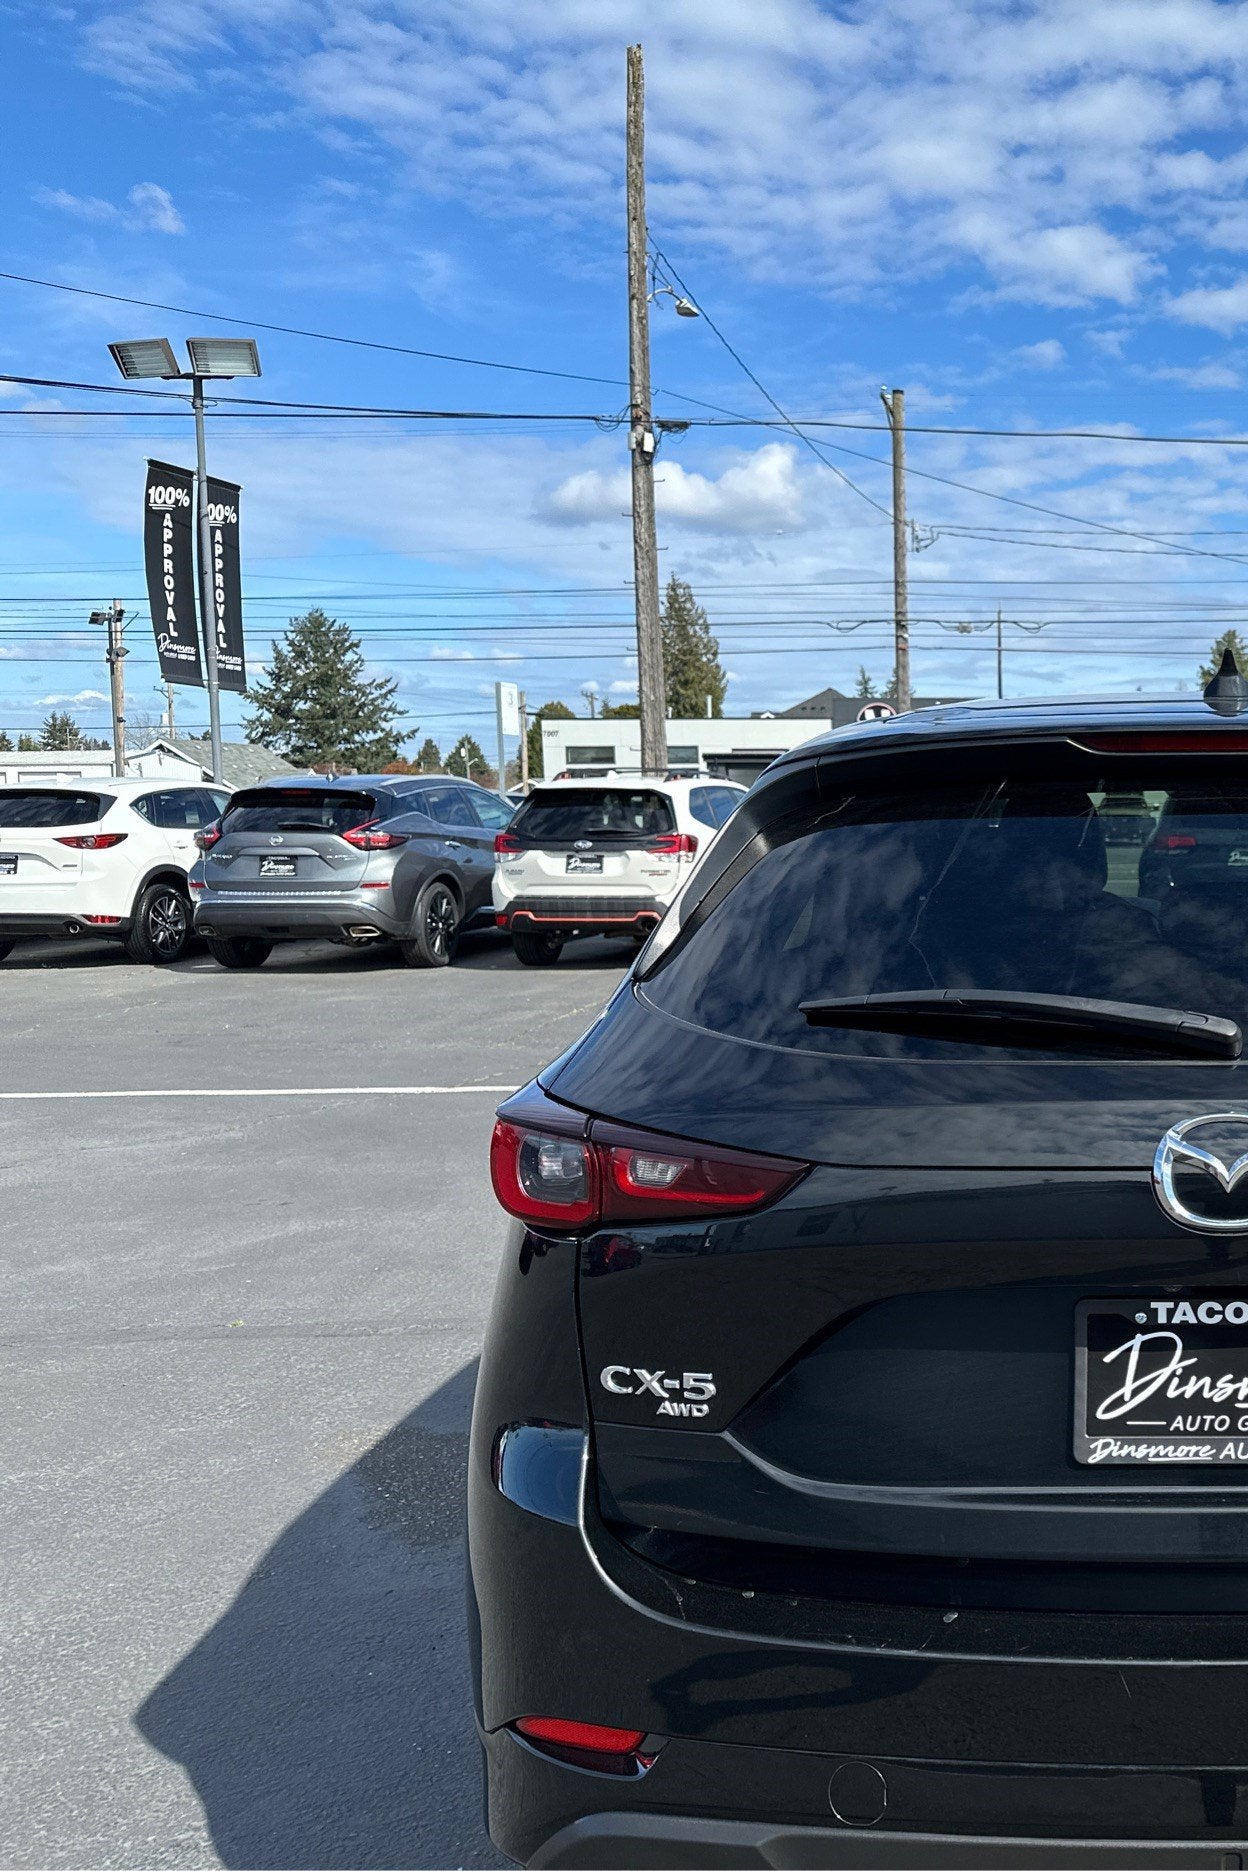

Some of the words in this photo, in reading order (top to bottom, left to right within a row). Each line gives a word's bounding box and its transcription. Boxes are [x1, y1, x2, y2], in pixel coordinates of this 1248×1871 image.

[148, 486, 190, 508] 100%
[207, 503, 237, 524] 00%
[163, 513, 178, 637] APPROVAL
[215, 529, 226, 648] APPROVAL
[600, 1365, 717, 1400] CX-5
[656, 1400, 710, 1418] AWD
[1169, 1415, 1231, 1431] AUTO
[1087, 1438, 1216, 1463] Dinsmore
